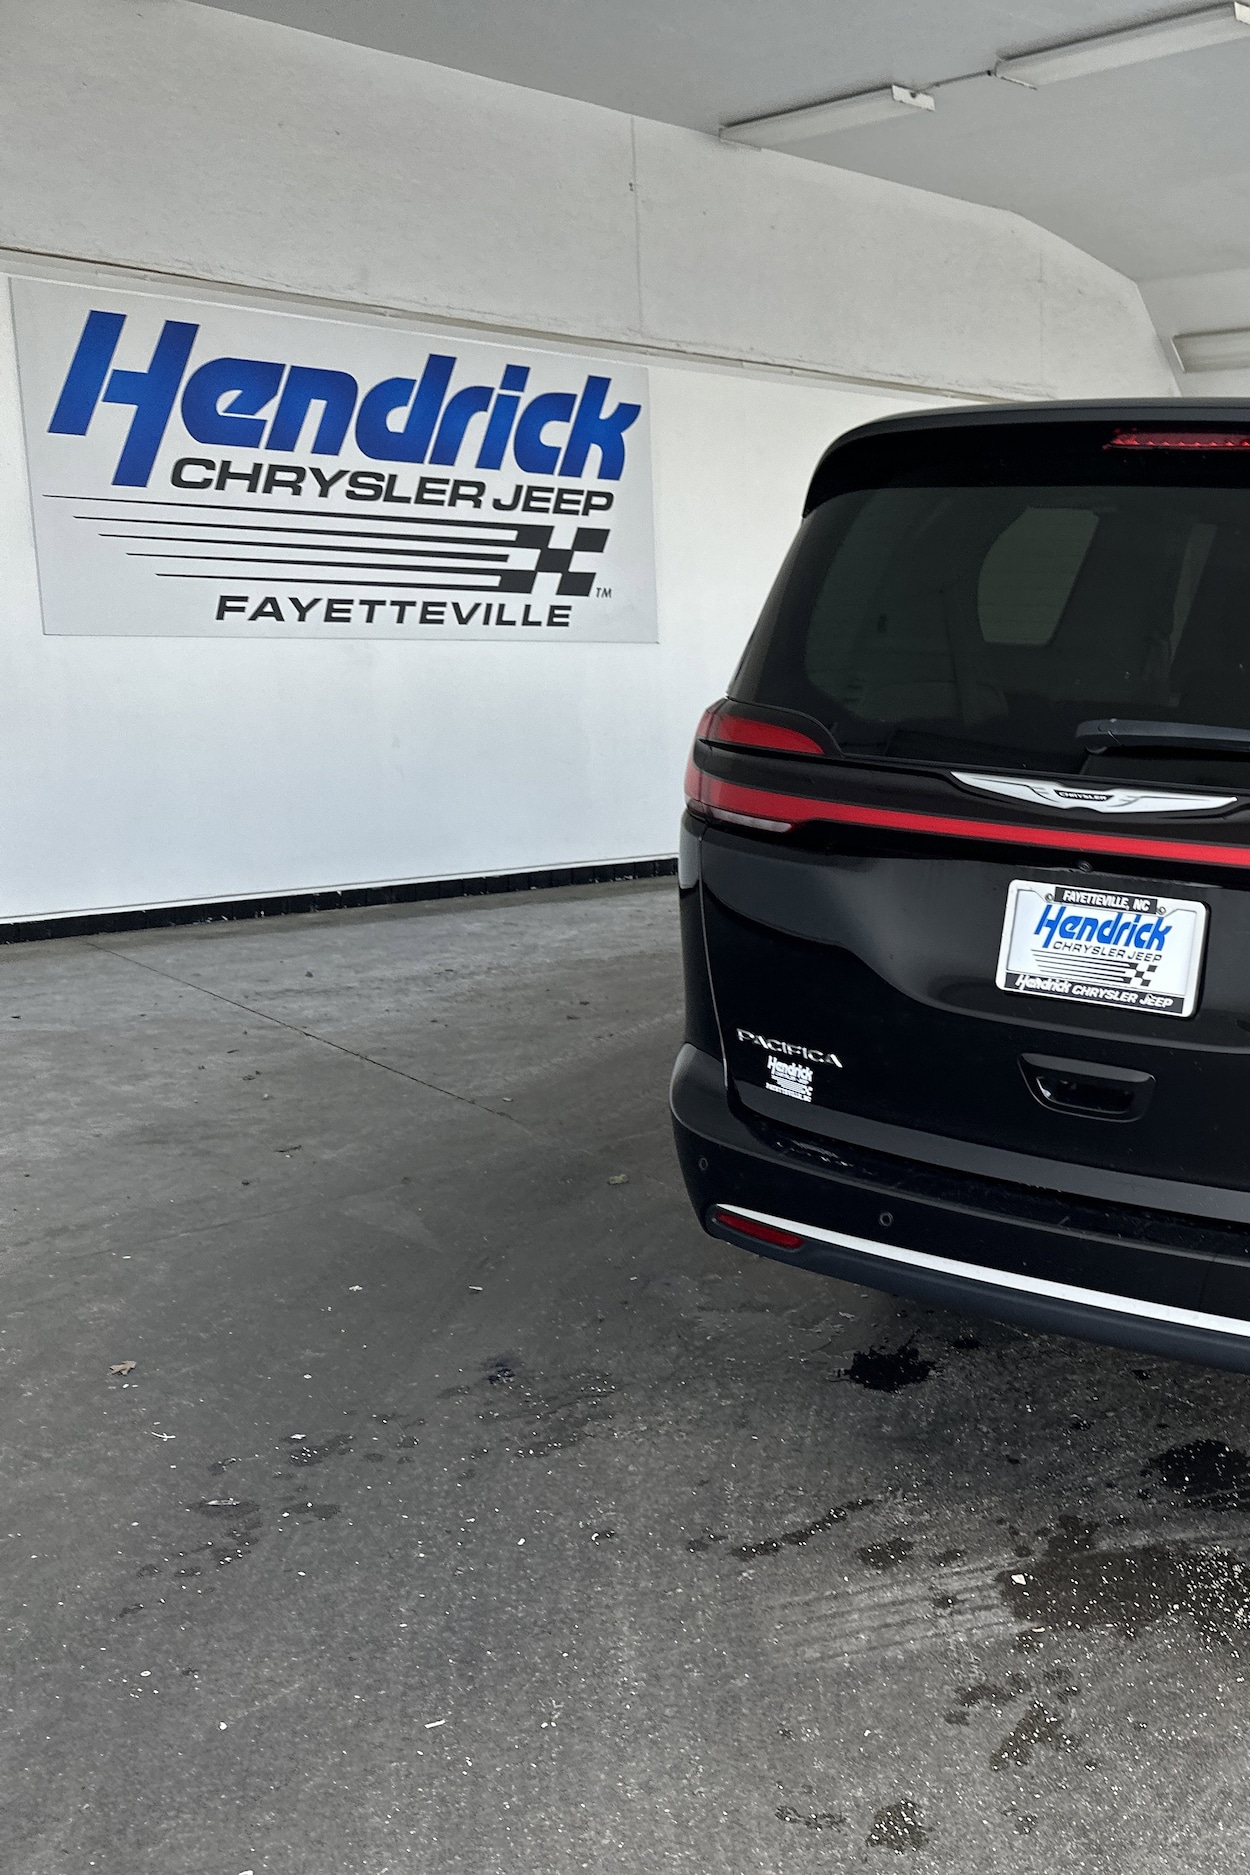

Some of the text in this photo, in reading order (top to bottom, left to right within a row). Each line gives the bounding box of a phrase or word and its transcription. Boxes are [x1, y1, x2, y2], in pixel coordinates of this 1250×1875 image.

[48, 310, 641, 487] Hendrick
[170, 457, 614, 516] CHRYSLER JEEP
[215, 595, 573, 628] FAYETTEVILLE
[1133, 900, 1151, 912] NC
[1034, 904, 1173, 951] Hendrick
[1053, 941, 1163, 963] CHRYSLER JEEP
[1015, 974, 1072, 992] Hendrick
[1071, 984, 1138, 1004] CHRYSLER
[736, 1027, 844, 1068] PACIFICA
[767, 1055, 814, 1082] Hendrick
